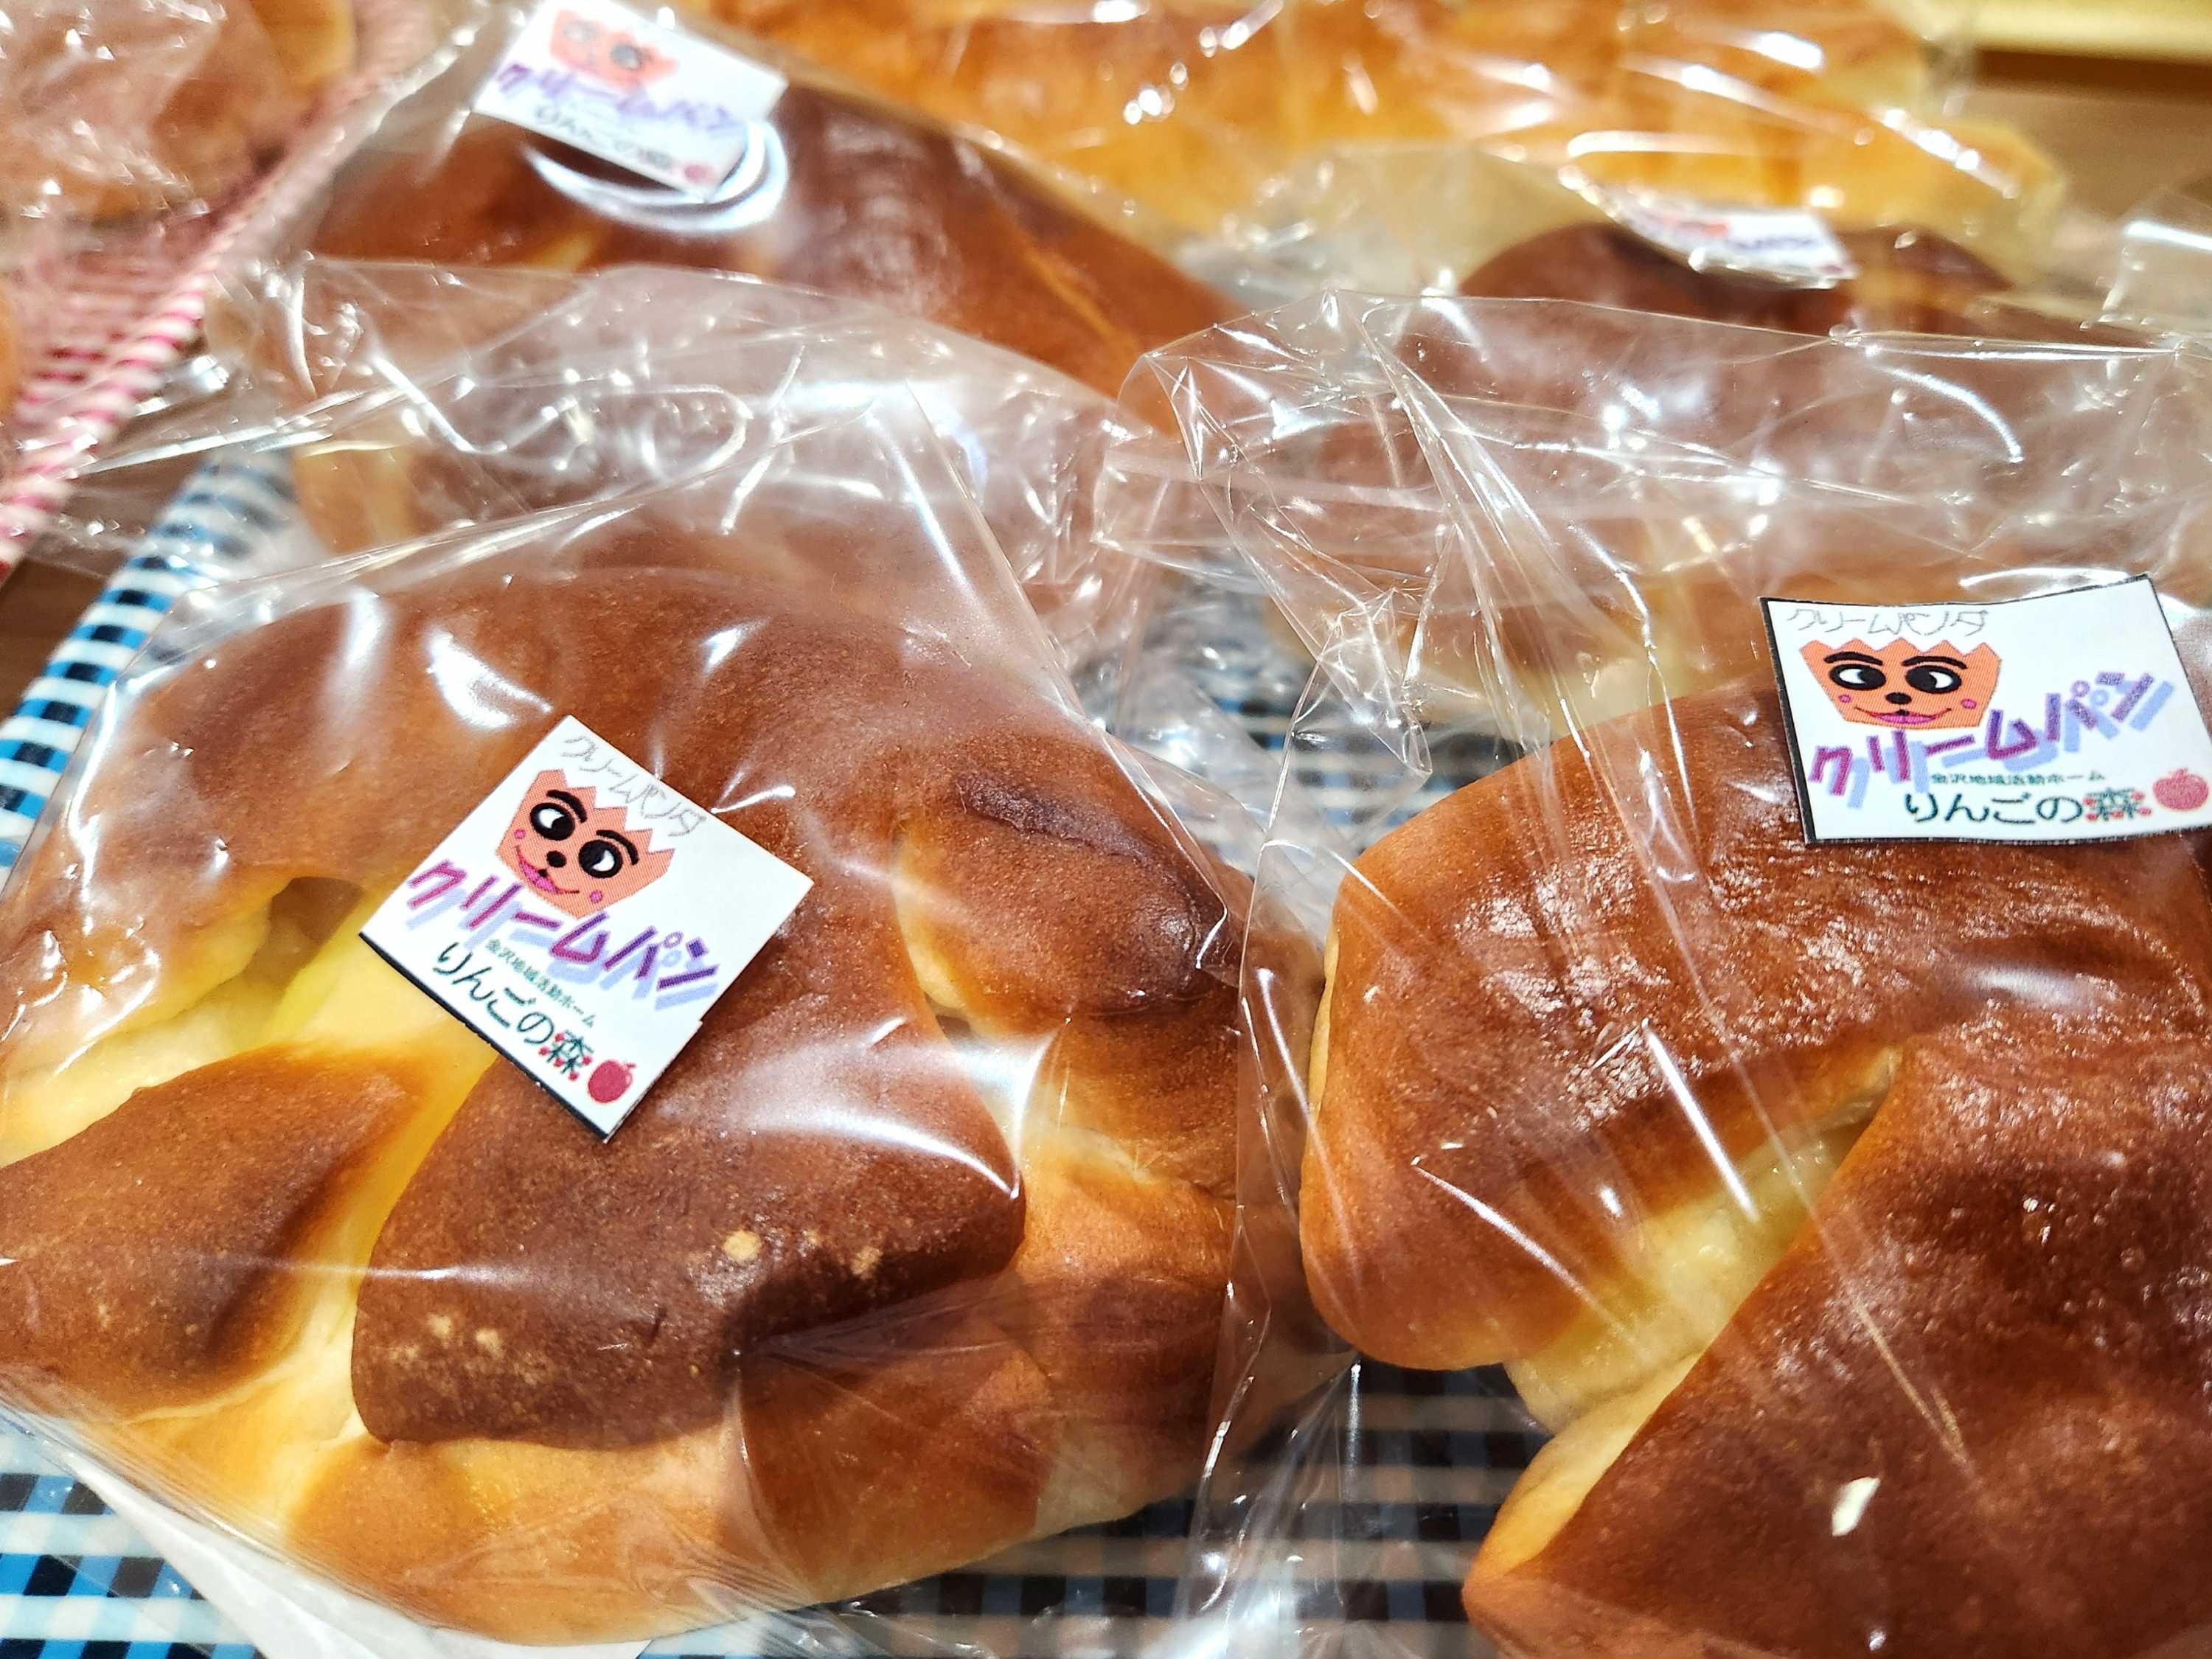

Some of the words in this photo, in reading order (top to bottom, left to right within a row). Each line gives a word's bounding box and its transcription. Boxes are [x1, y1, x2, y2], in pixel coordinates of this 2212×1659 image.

[1808, 671, 2168, 805] クリームパン
[1905, 787, 2152, 824] りんごの森
[406, 858, 719, 1007] クリームパン
[433, 942, 594, 1082] りんごの森
